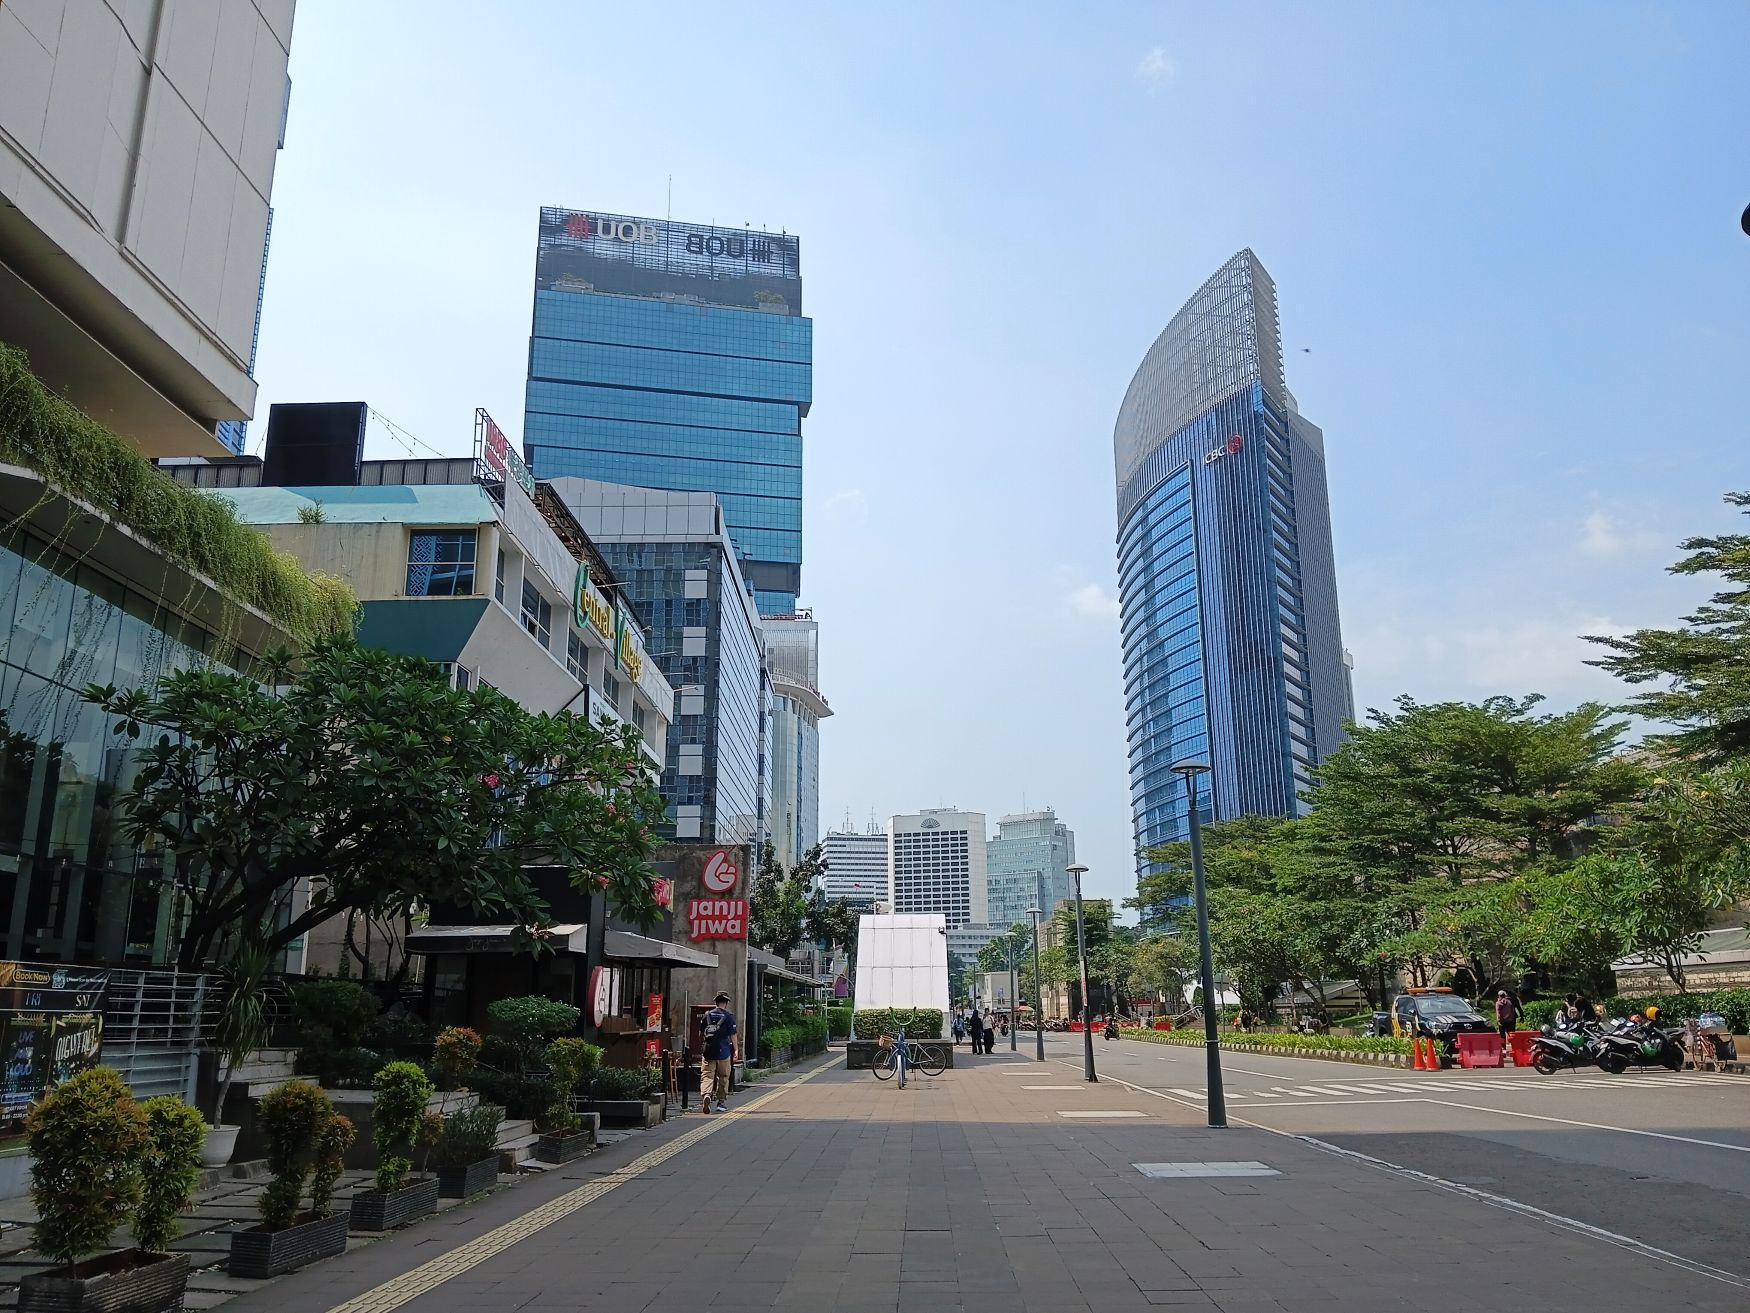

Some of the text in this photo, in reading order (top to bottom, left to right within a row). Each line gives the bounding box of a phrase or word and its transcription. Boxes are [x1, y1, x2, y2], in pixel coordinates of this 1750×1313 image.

[597, 218, 658, 245] UOB
[614, 605, 643, 683] Village
[15, 971, 48, 982] Book Now
